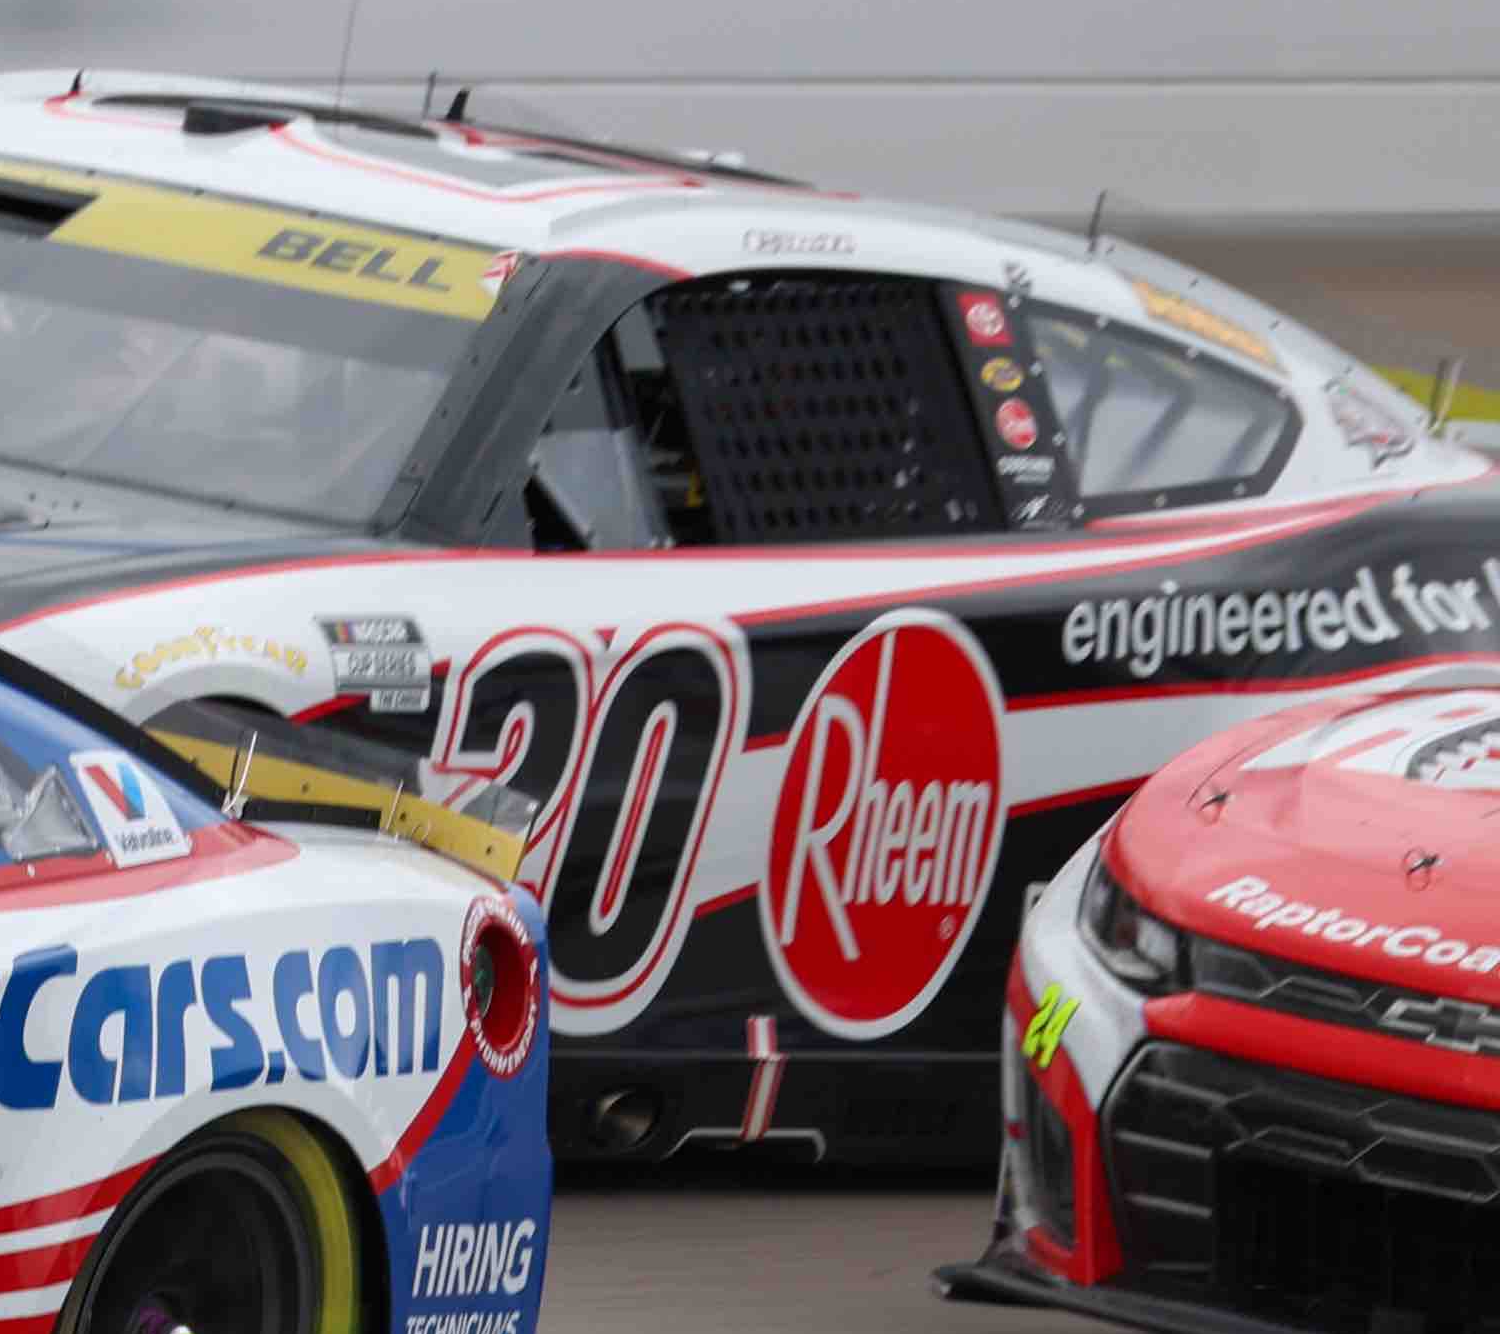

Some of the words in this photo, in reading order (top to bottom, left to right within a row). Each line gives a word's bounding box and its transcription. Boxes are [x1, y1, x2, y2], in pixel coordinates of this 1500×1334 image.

[256, 228, 454, 293] BELL
[1062, 566, 1402, 678] engineered
[1392, 563, 1491, 634] for
[780, 629, 991, 961] Rheem
[1022, 982, 1081, 1069] 24
[412, 1218, 537, 1299] HIRING
